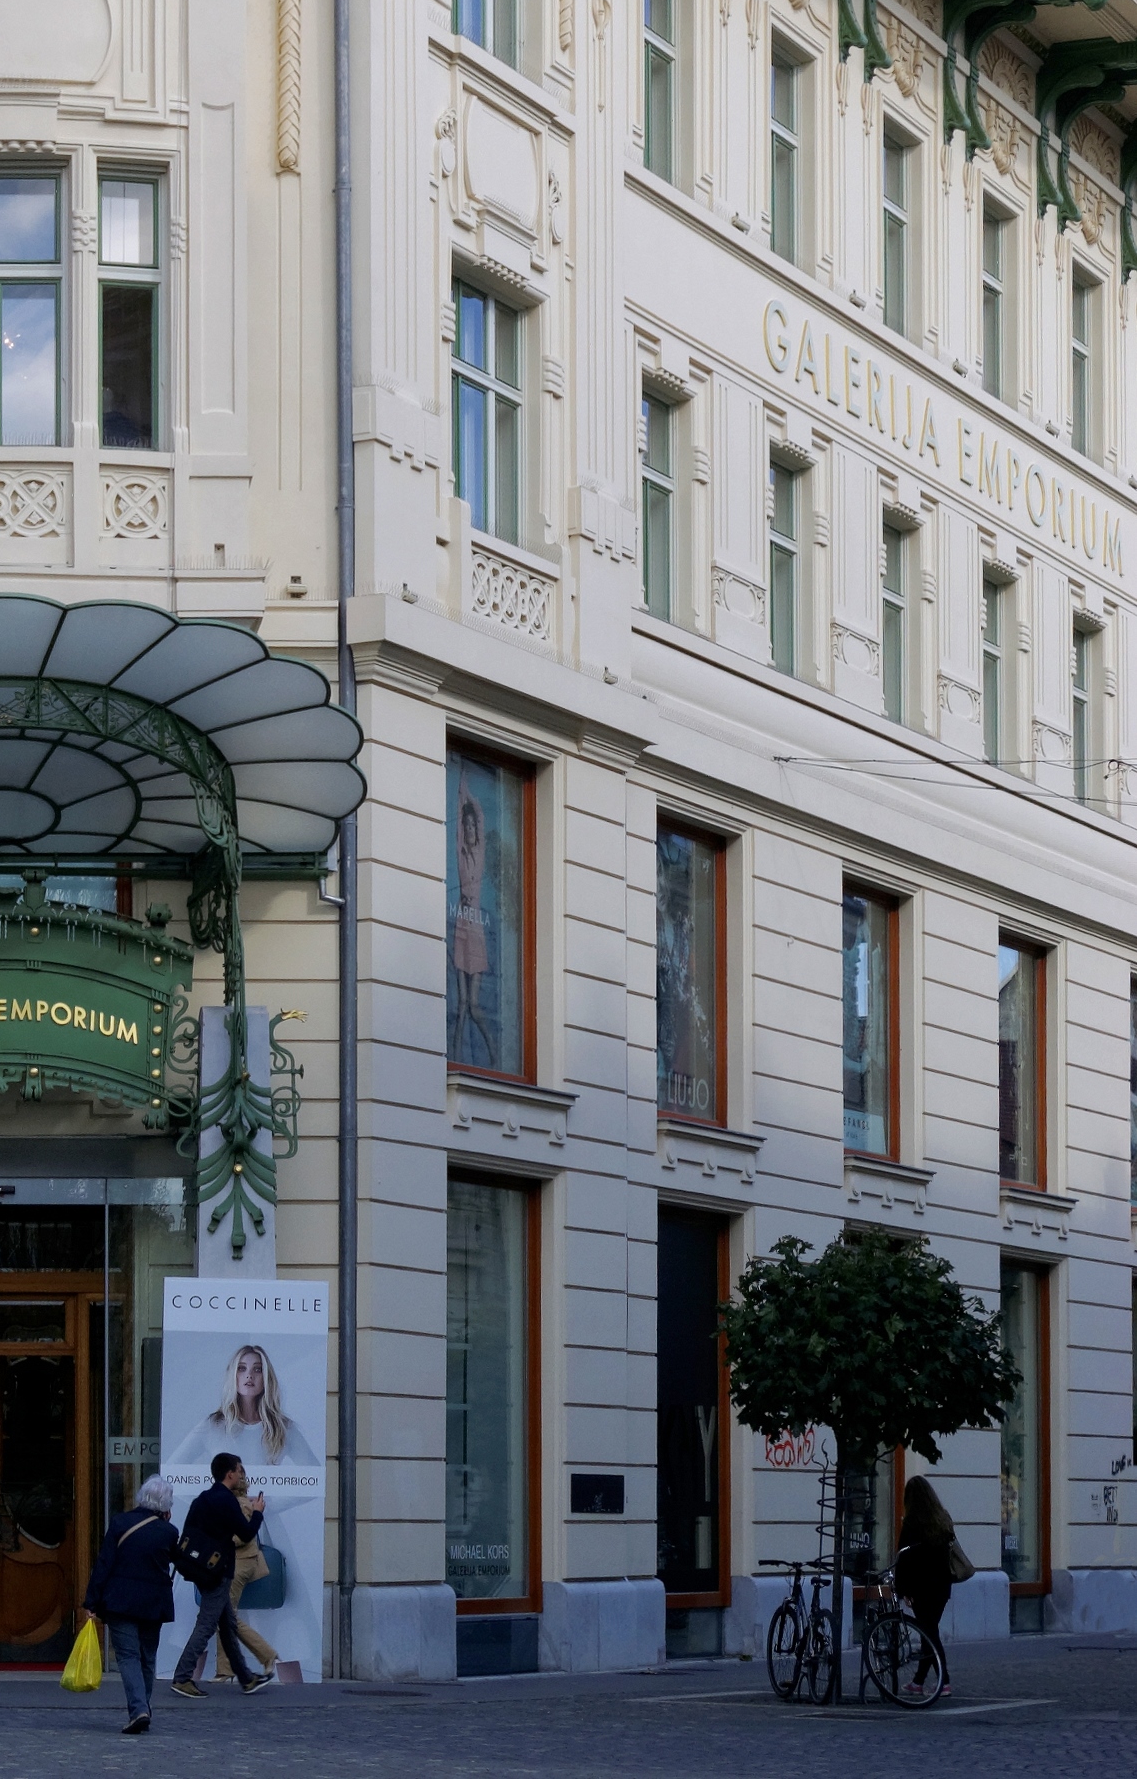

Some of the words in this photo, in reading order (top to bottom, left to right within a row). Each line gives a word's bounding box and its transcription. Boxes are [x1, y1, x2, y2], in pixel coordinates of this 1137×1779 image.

[762, 298, 942, 467] GALERIJA
[957, 417, 1126, 577] EMPORIUM
[449, 902, 491, 927] MARELLA
[172, 1294, 322, 1313] COCCINELLE
[166, 1475, 201, 1485] DANES
[270, 1476, 319, 1486] TORBICO!
[450, 1544, 486, 1560] MICHAEL
[487, 1544, 510, 1559] KORS
